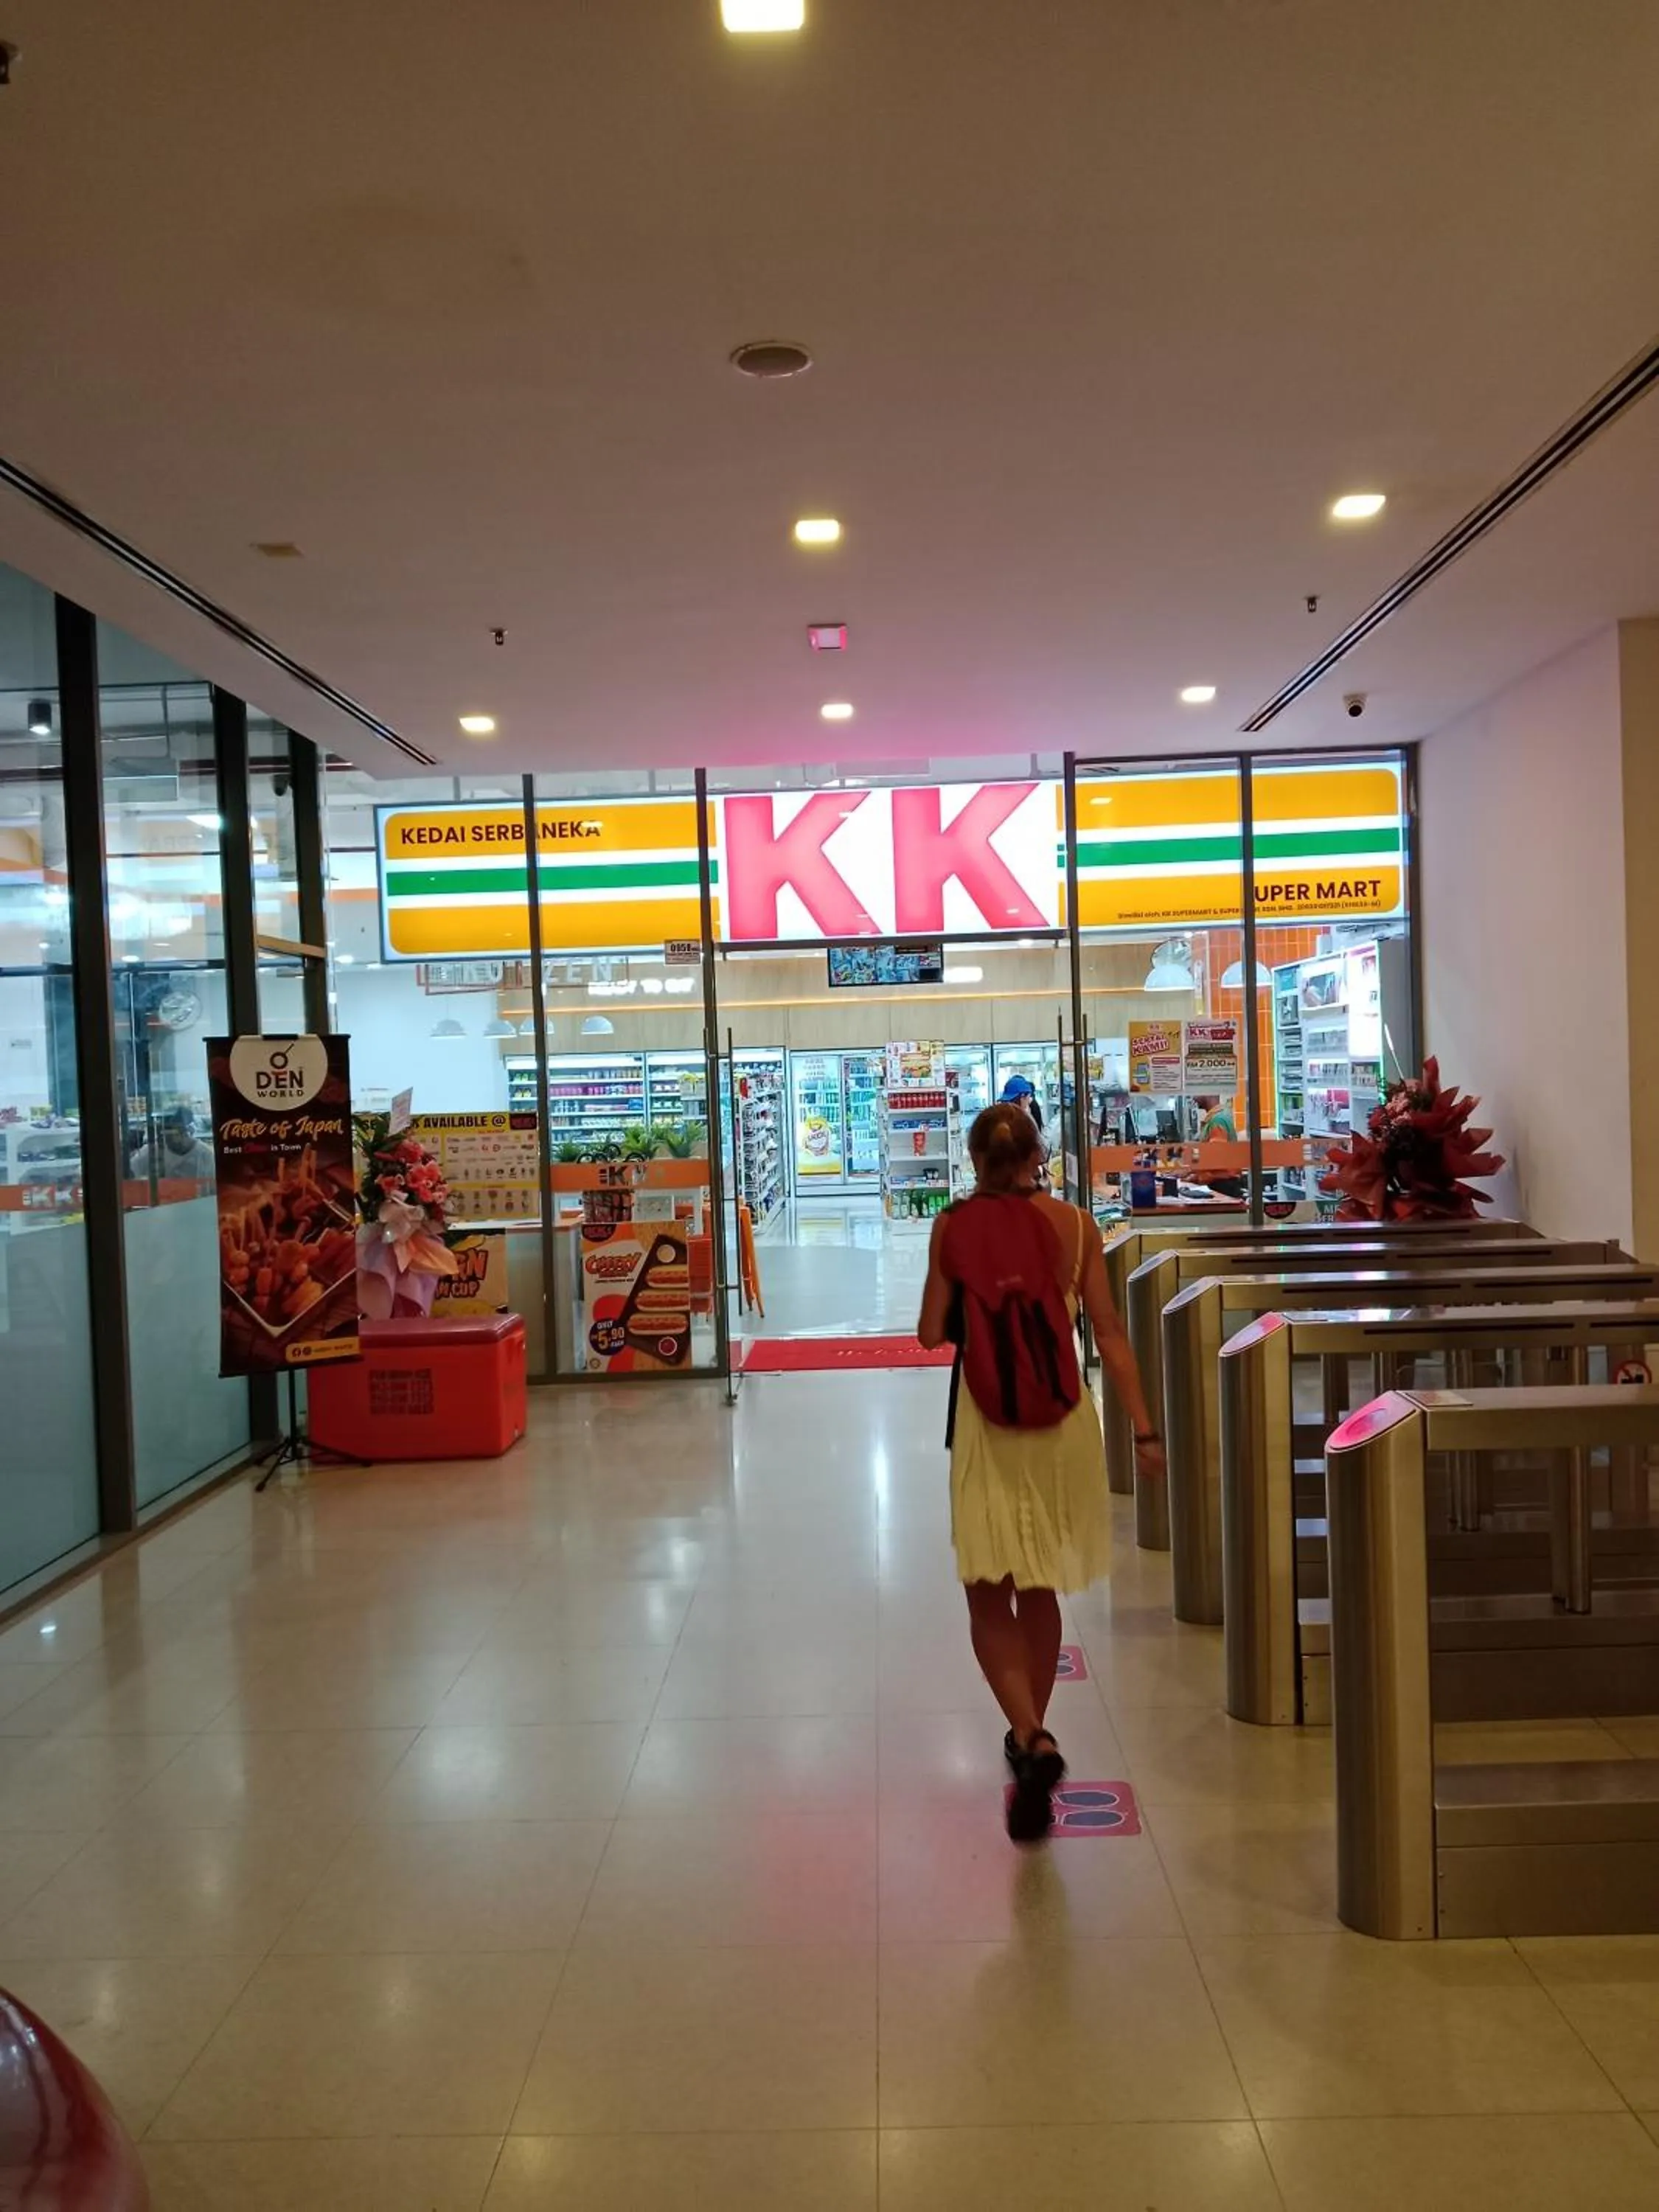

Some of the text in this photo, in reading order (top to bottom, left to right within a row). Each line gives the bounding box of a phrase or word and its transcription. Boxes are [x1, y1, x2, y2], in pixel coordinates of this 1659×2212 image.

[401, 821, 600, 844] KEDAI SERBNEKA
[723, 782, 1050, 940] KK
[1254, 880, 1380, 902] UPER MART
[256, 1070, 305, 1089] DEN
[257, 1089, 305, 1098] WORLD
[220, 1118, 268, 1141] Taste
[270, 1119, 293, 1139] of
[295, 1115, 344, 1141] Japan
[423, 1116, 487, 1128] AVAILABLE
[223, 1146, 242, 1154] Best
